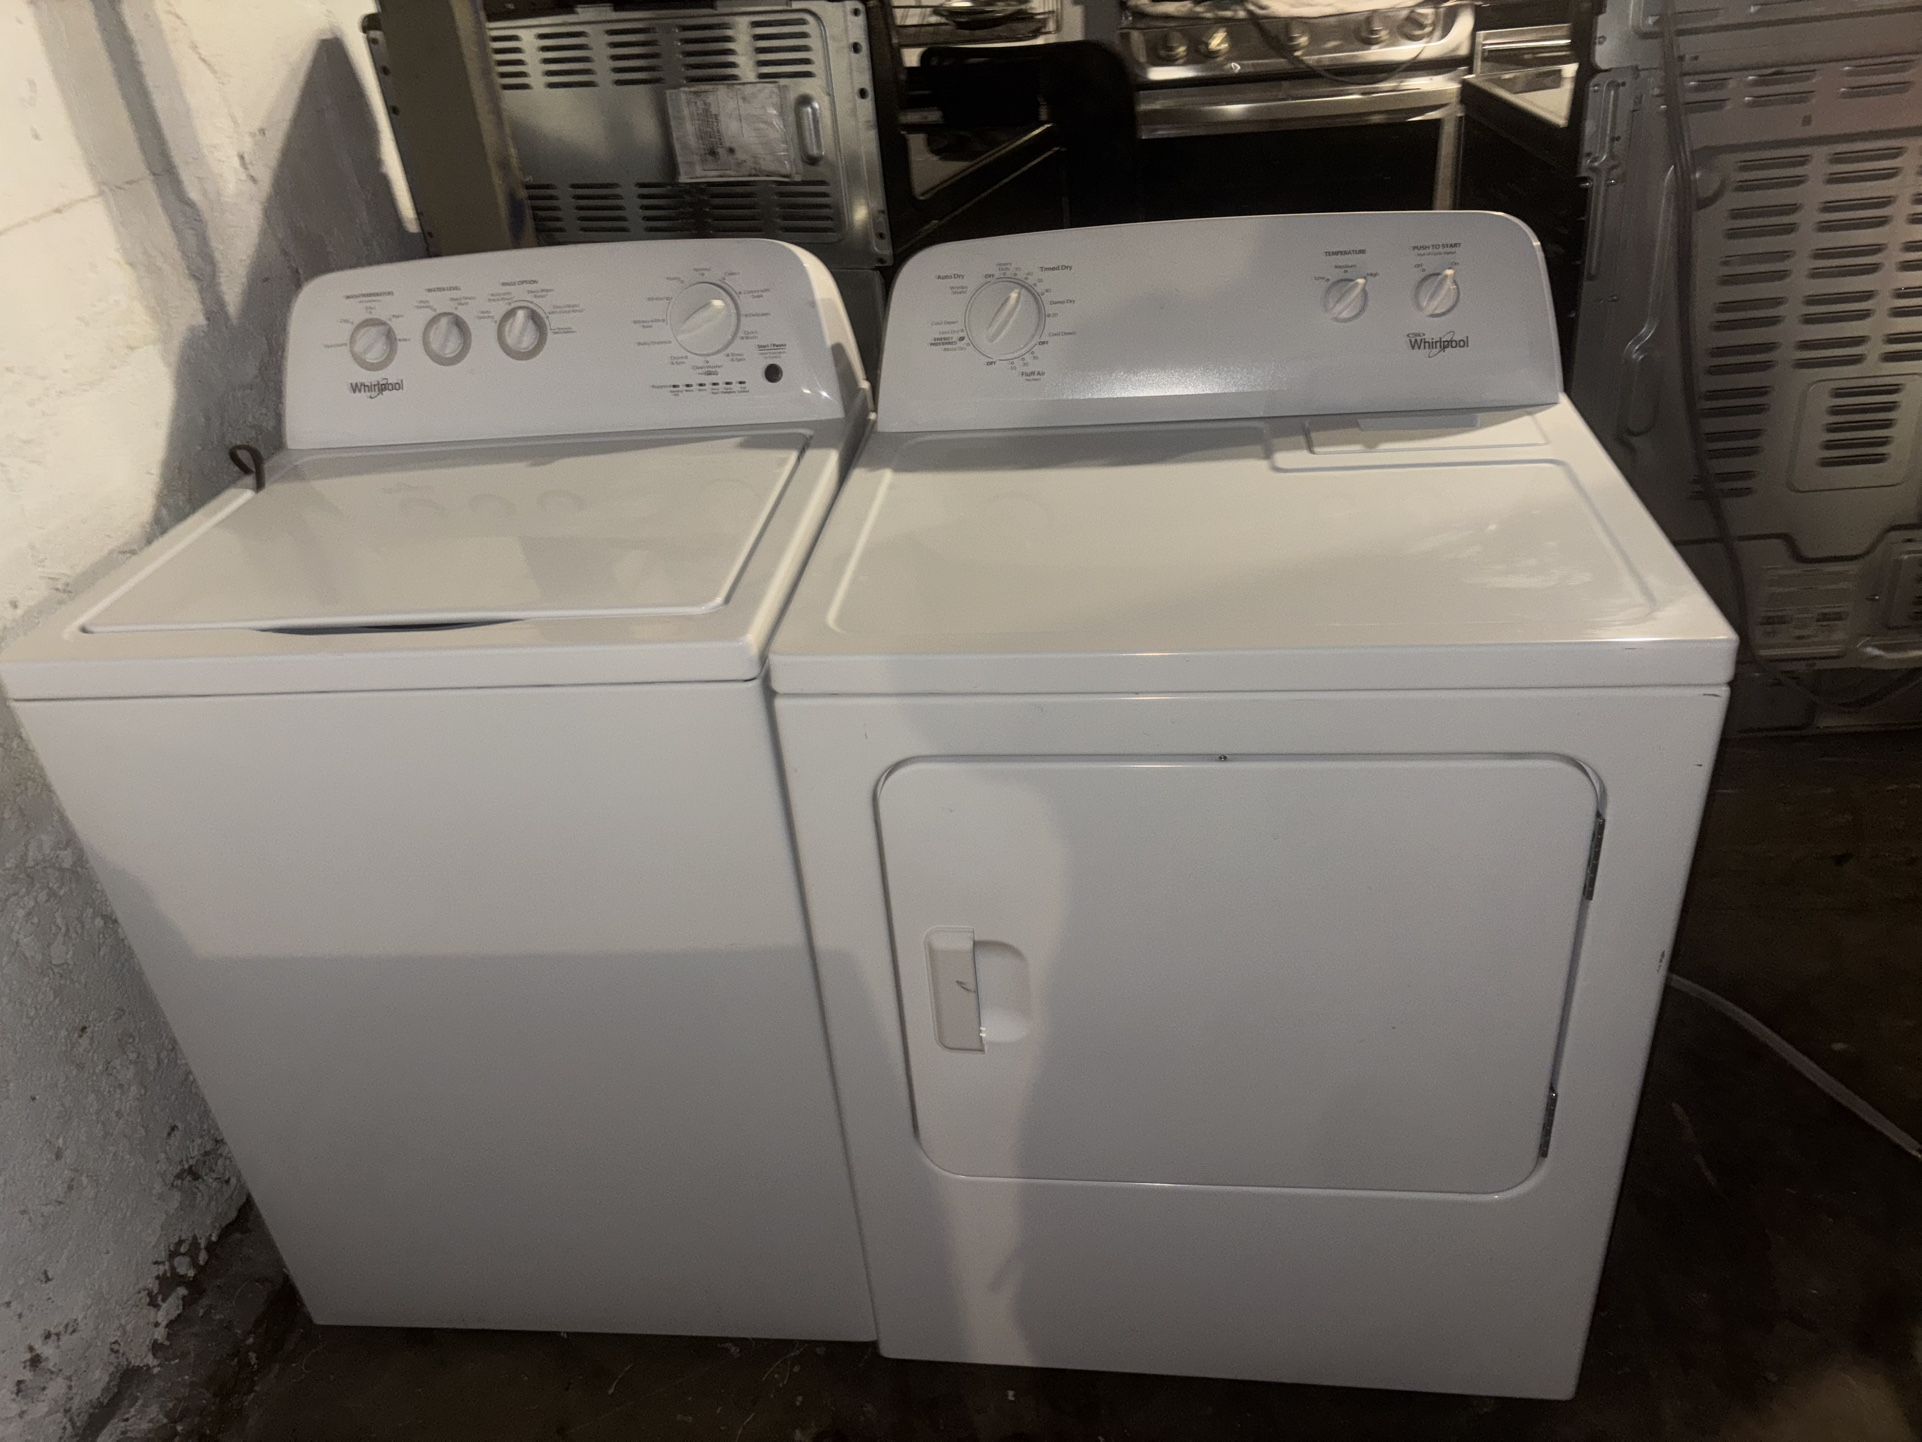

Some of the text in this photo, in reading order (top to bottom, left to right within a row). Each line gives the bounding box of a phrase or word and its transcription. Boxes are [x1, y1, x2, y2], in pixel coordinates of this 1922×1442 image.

[1324, 249, 1367, 257] TEMPERATURE
[1408, 336, 1469, 352] Whirlpool
[350, 379, 404, 396] Whirlpool
